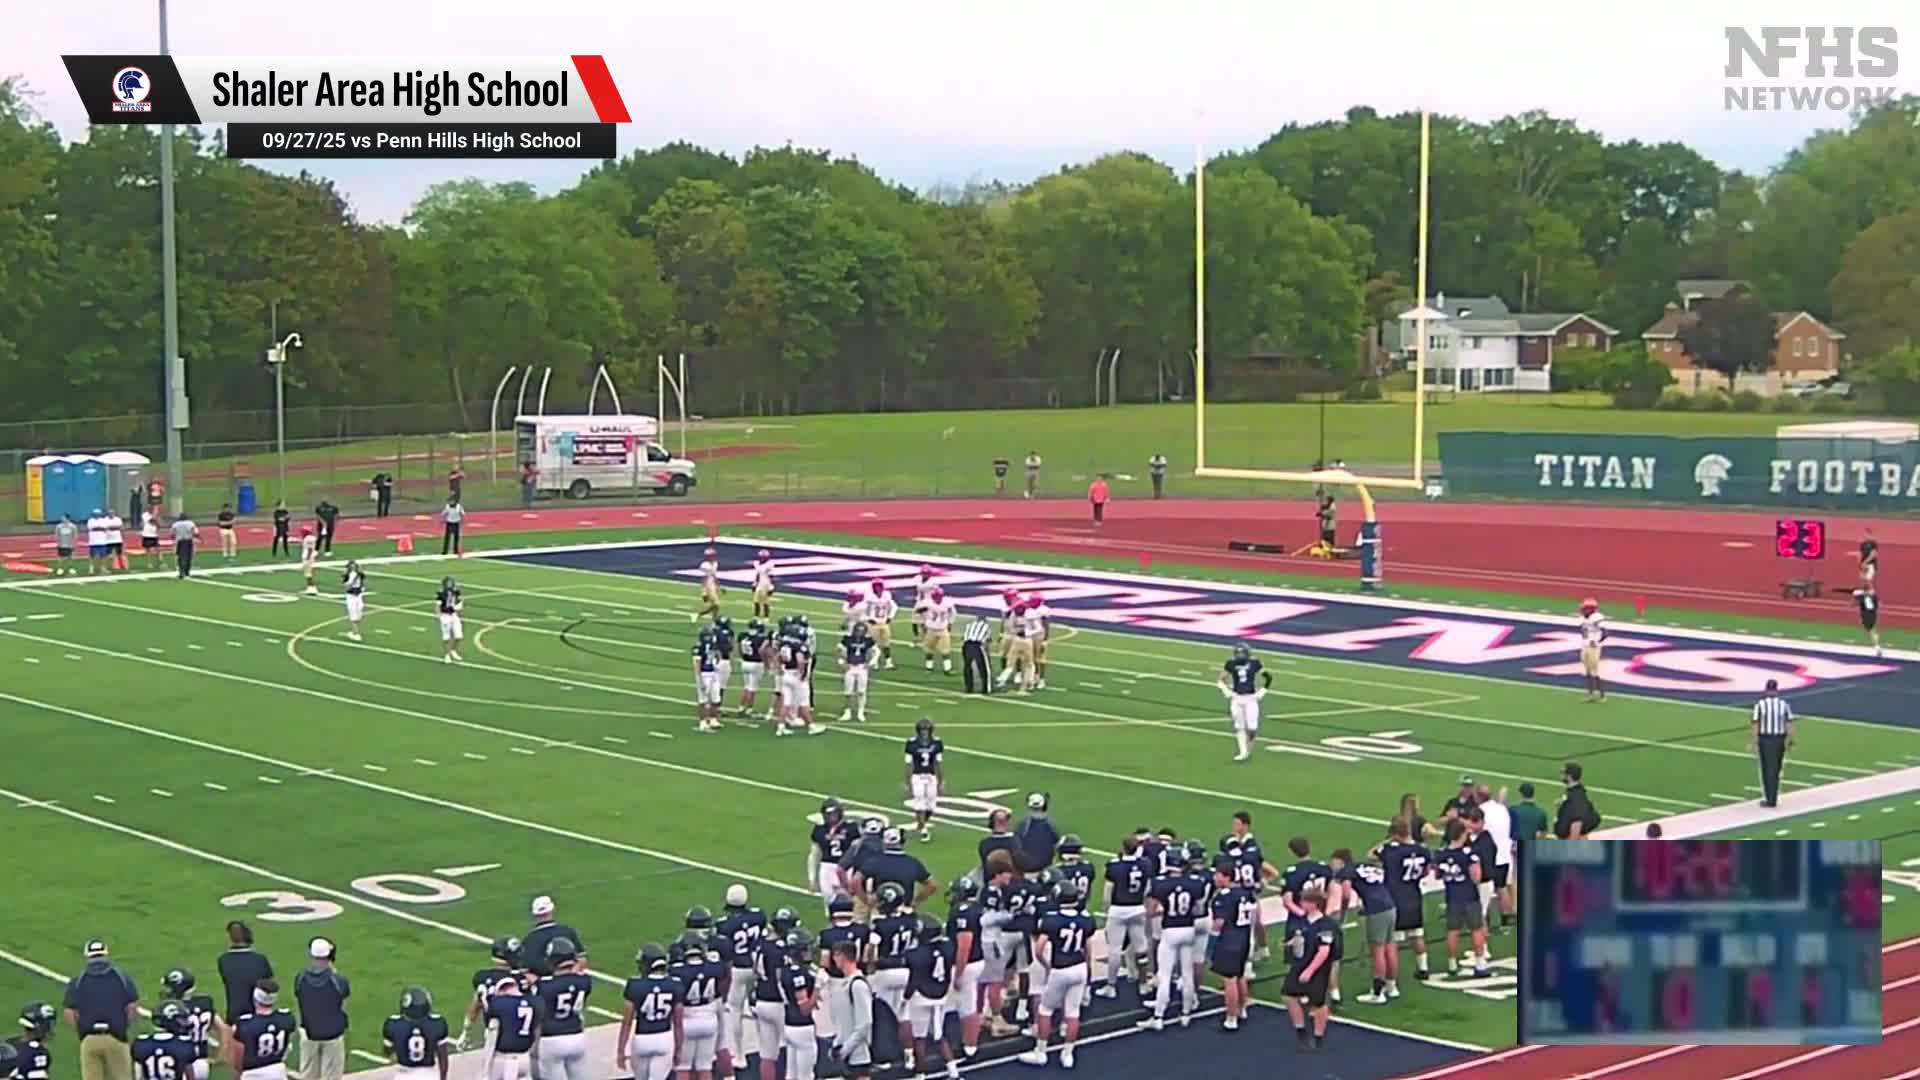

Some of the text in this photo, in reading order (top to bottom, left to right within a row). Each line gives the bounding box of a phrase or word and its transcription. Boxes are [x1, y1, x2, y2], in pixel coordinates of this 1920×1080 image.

[1535, 454, 1656, 489] TITAN
[1777, 521, 1823, 558] 23
[830, 840, 842, 857] 2
[1128, 871, 1142, 894] 5
[1402, 857, 1426, 881] 75
[220, 874, 466, 922] 30
[733, 925, 760, 954] 27
[1059, 928, 1085, 953] 71
[932, 956, 946, 982] 4
[686, 978, 716, 1004] 44
[555, 990, 586, 1021] 54
[640, 993, 674, 1020] 45
[517, 1006, 533, 1036] 7
[257, 1030, 286, 1057] 81
[145, 1055, 176, 1080] 16
